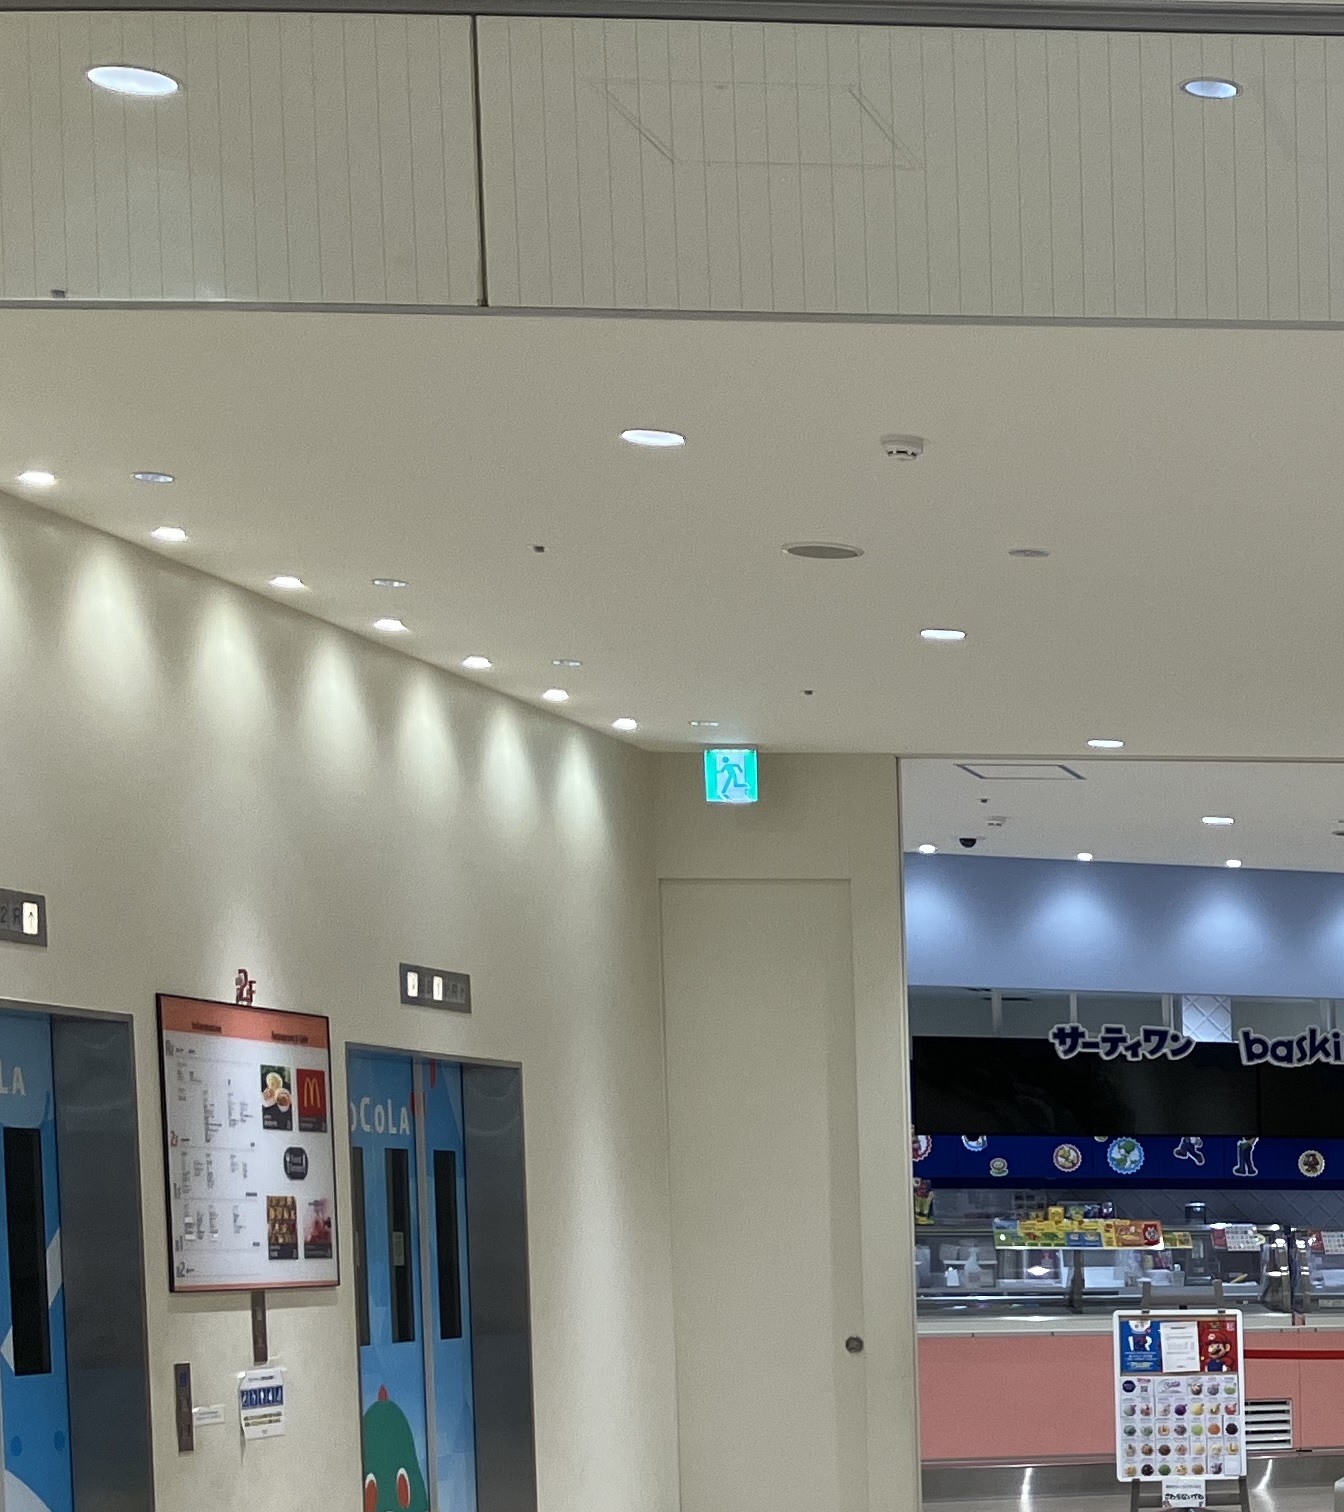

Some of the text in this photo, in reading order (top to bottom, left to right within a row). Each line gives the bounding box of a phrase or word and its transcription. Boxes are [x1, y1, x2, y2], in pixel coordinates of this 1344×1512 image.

[1050, 1023, 1196, 1060] サーティワン
